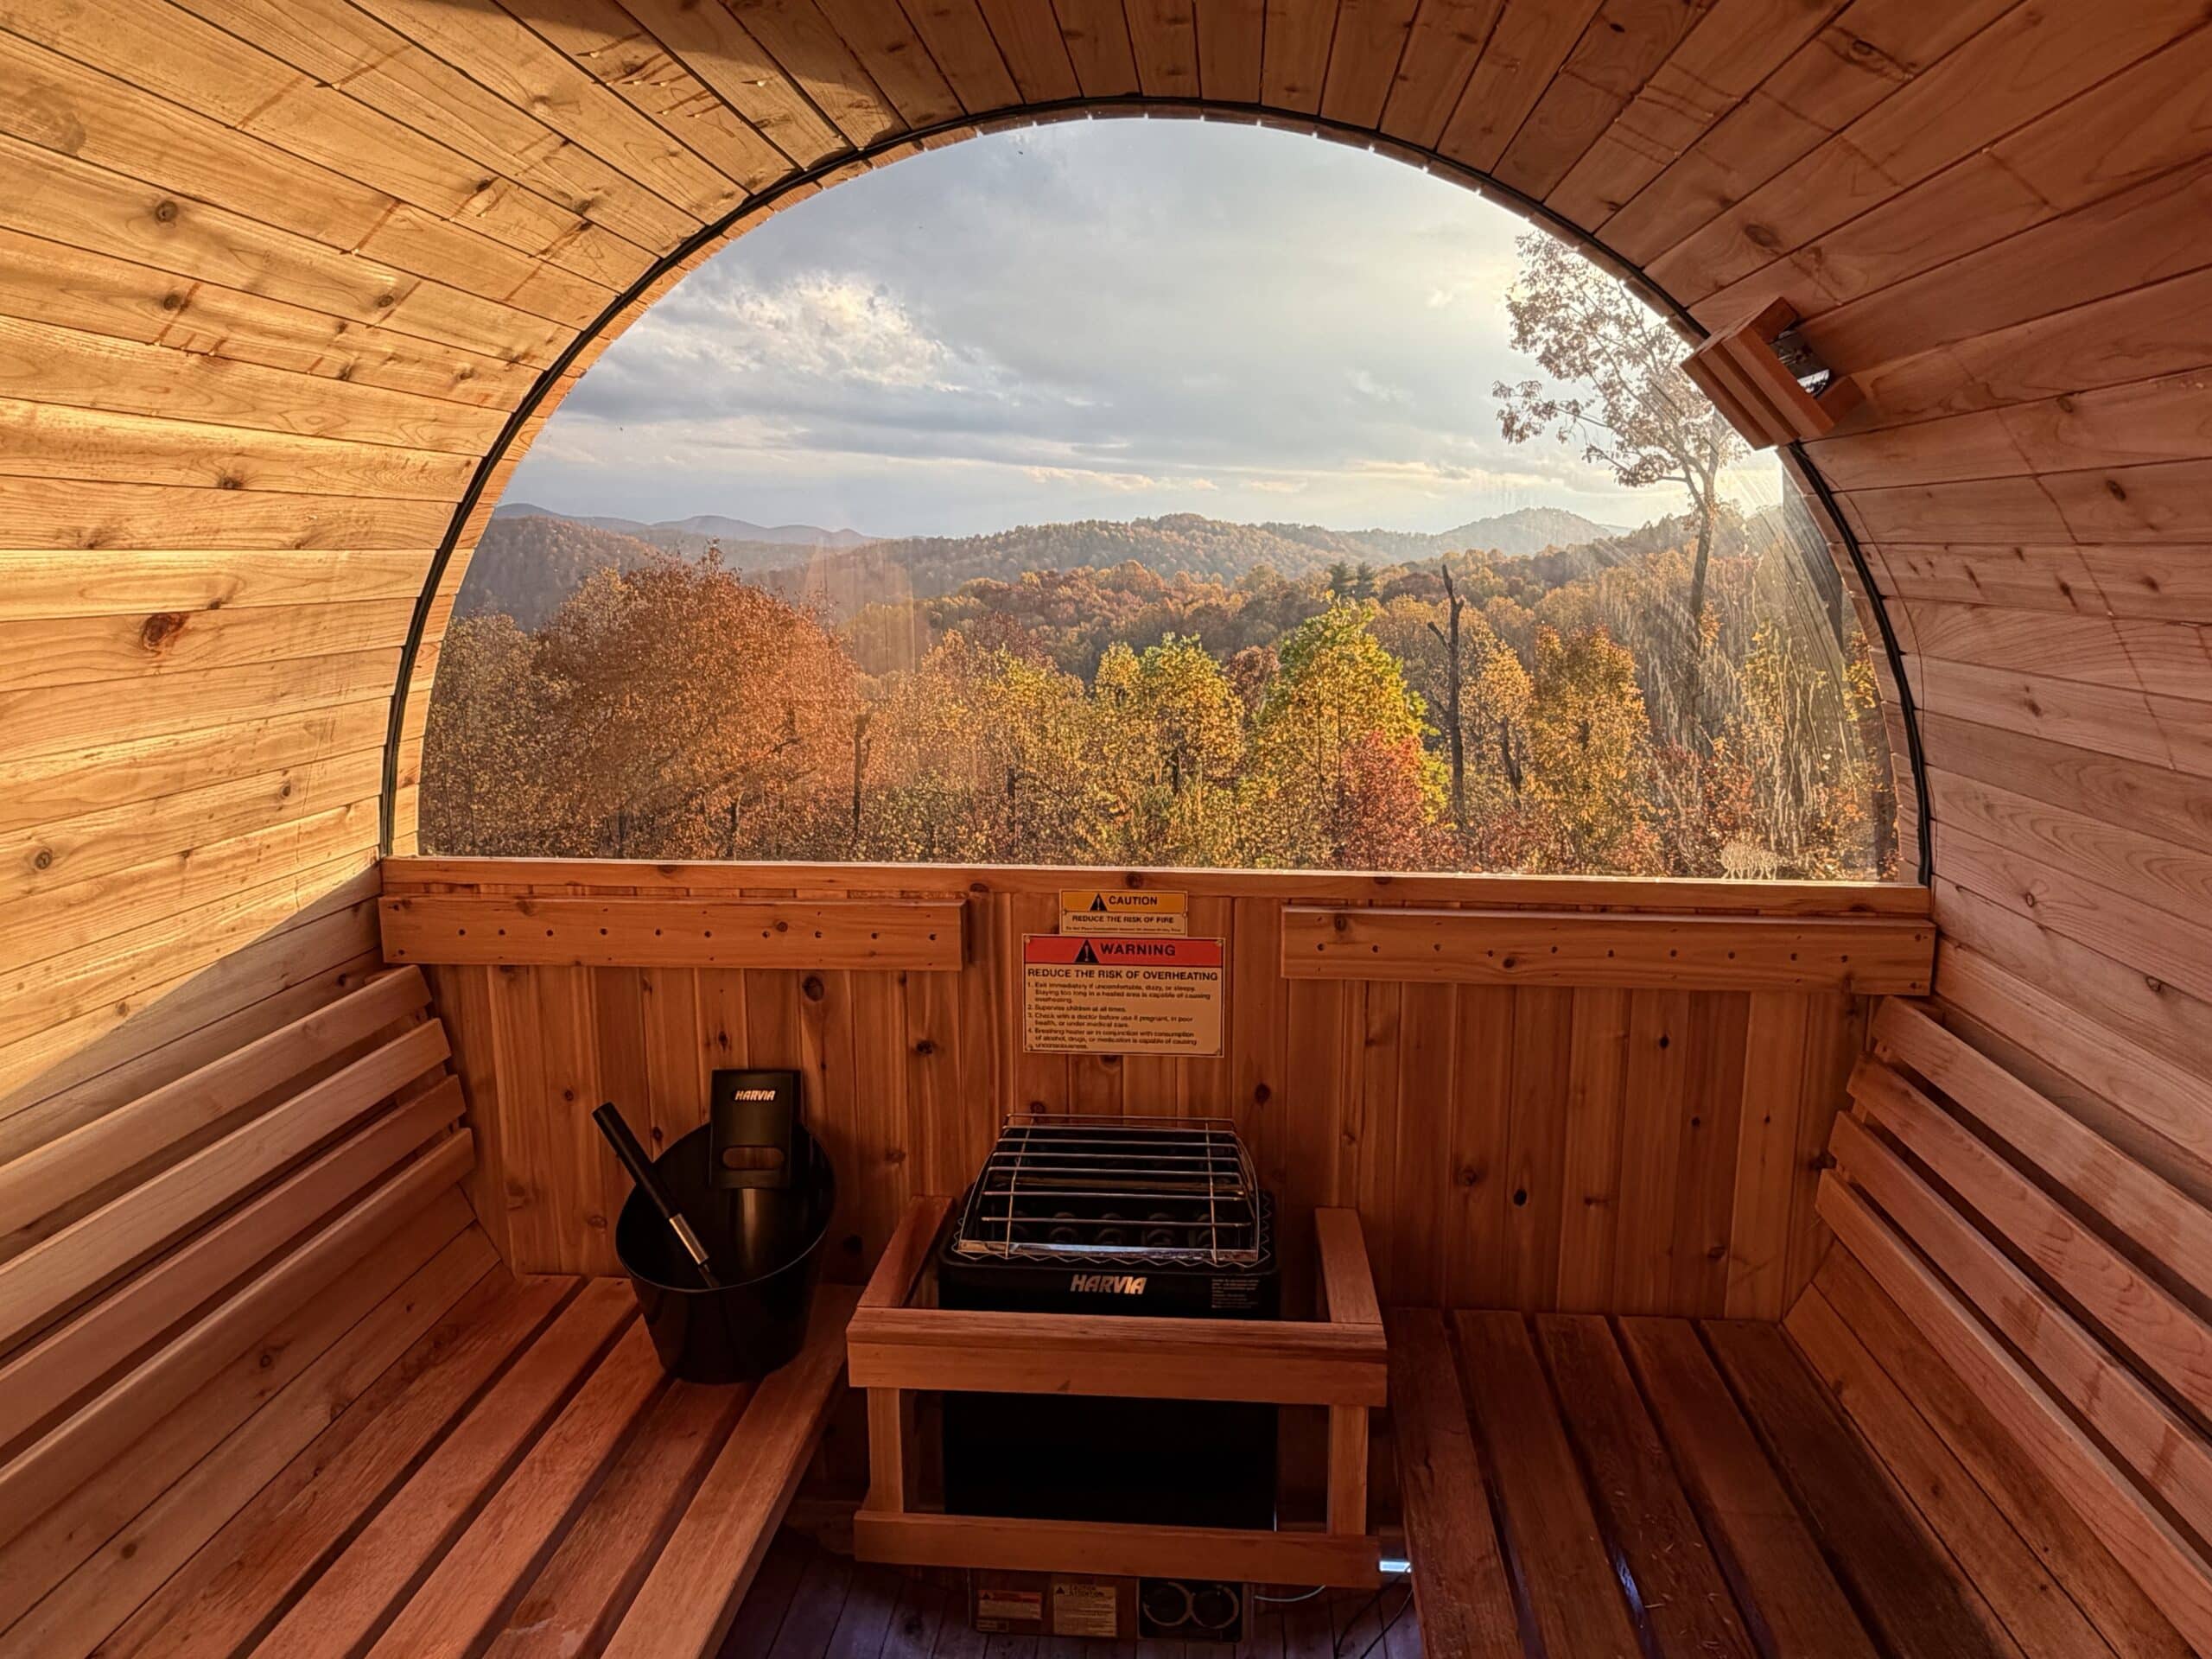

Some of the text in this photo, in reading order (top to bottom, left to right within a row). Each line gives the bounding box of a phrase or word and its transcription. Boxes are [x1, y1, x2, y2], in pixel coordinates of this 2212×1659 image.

[1109, 895, 1158, 906] CAUTION
[1101, 944, 1176, 956] WARNING
[1027, 968, 1217, 981] REDUCE THE RISK OF OVERHEATING
[734, 1090, 776, 1101] HARVIA
[1070, 1274, 1147, 1295] HARVIA
